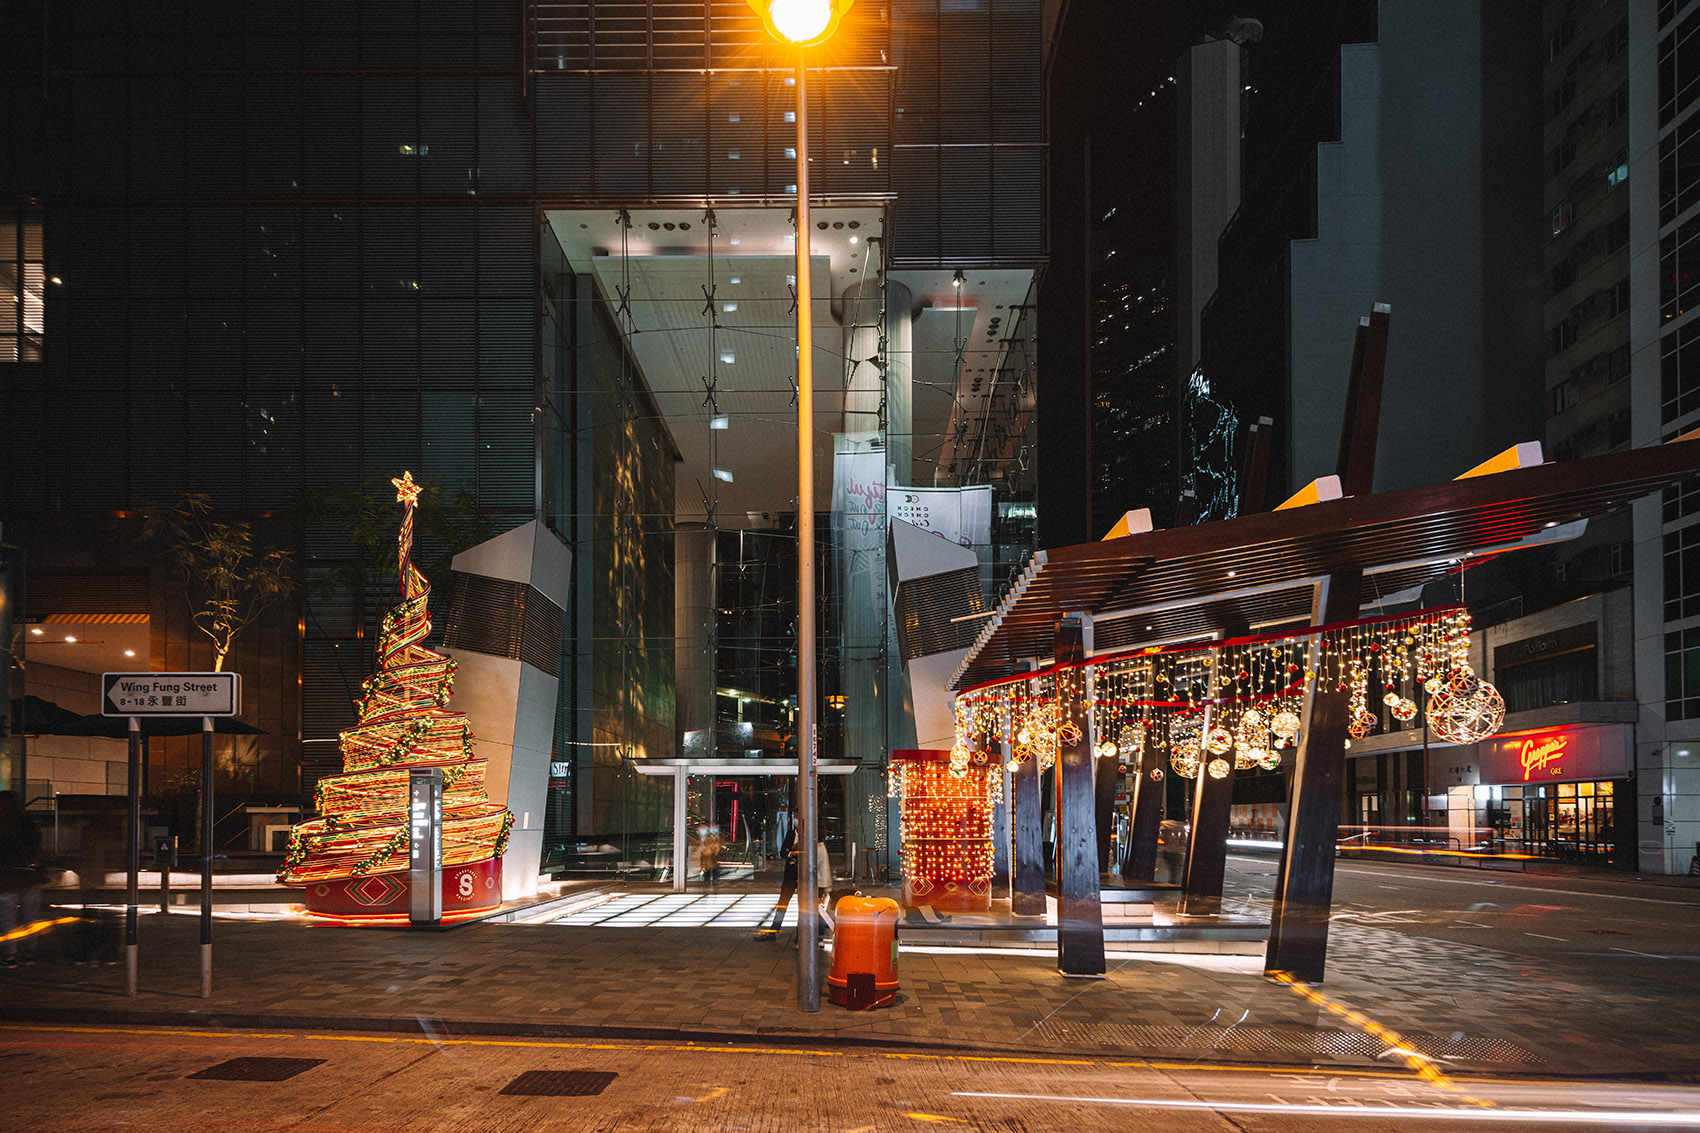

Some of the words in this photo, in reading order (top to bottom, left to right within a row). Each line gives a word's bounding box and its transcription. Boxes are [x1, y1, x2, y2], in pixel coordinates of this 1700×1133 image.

[120, 682, 149, 694] Wing
[153, 682, 180, 694] Fung
[183, 682, 217, 692] Street
[147, 696, 187, 706] 永豐街
